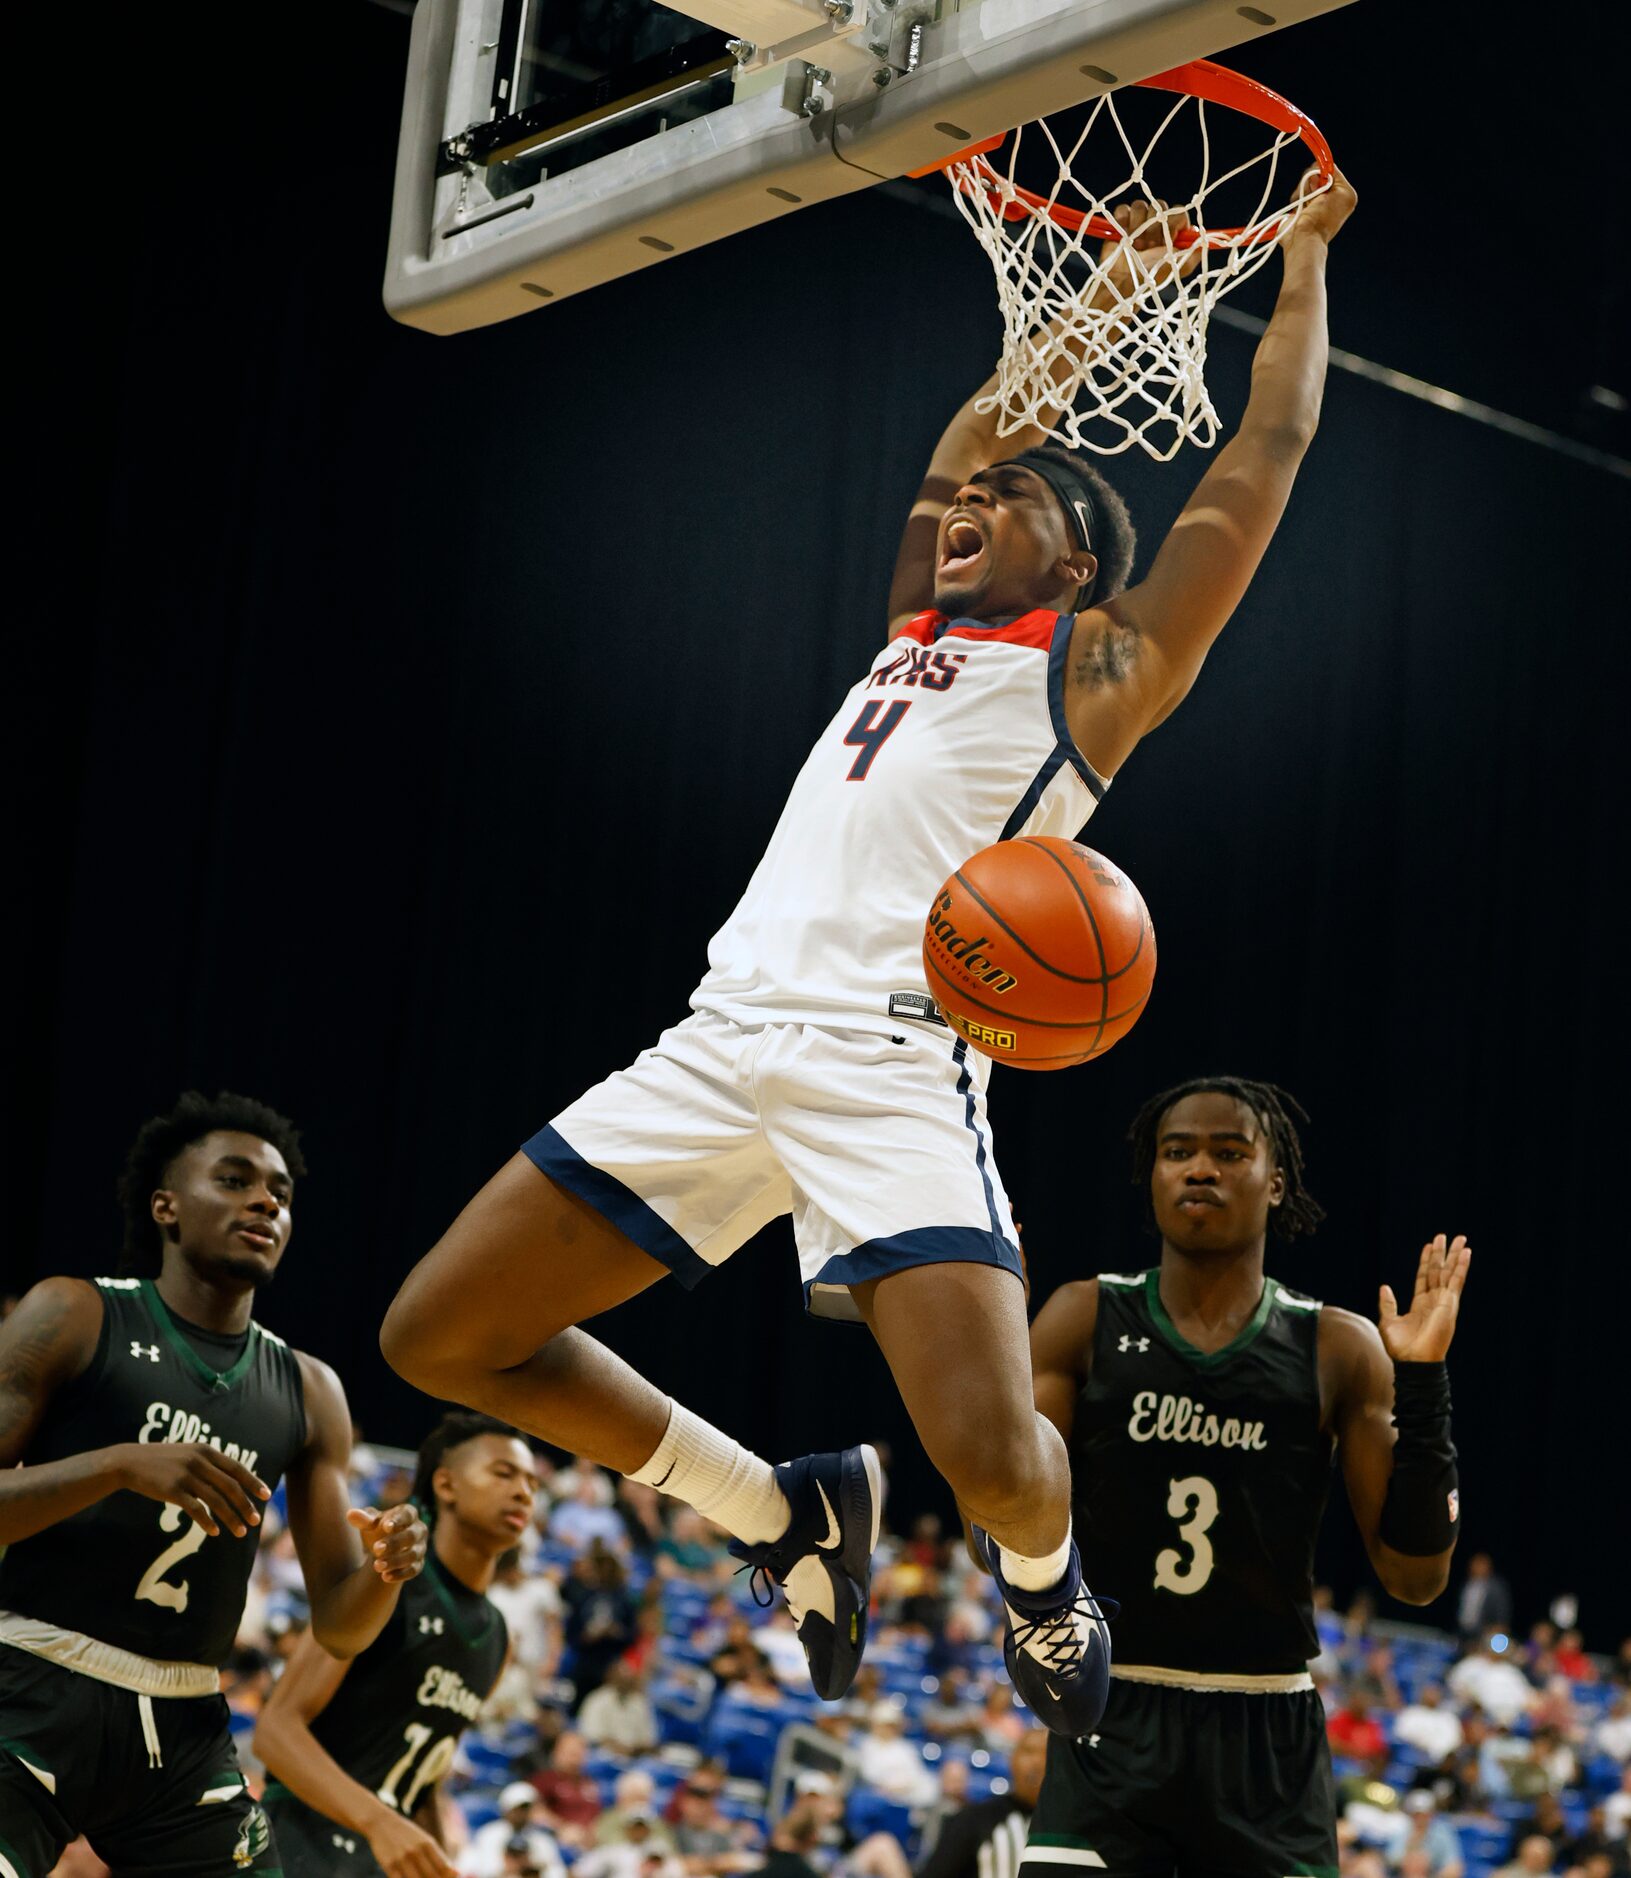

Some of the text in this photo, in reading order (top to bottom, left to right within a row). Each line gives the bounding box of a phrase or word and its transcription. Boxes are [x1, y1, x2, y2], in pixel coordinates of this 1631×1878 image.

[843, 699, 912, 781] 4
[968, 1023, 1012, 1048] PRO
[1128, 1390, 1267, 1451] Ellison
[135, 1498, 211, 1614] 2
[1153, 1475, 1220, 1595] 3
